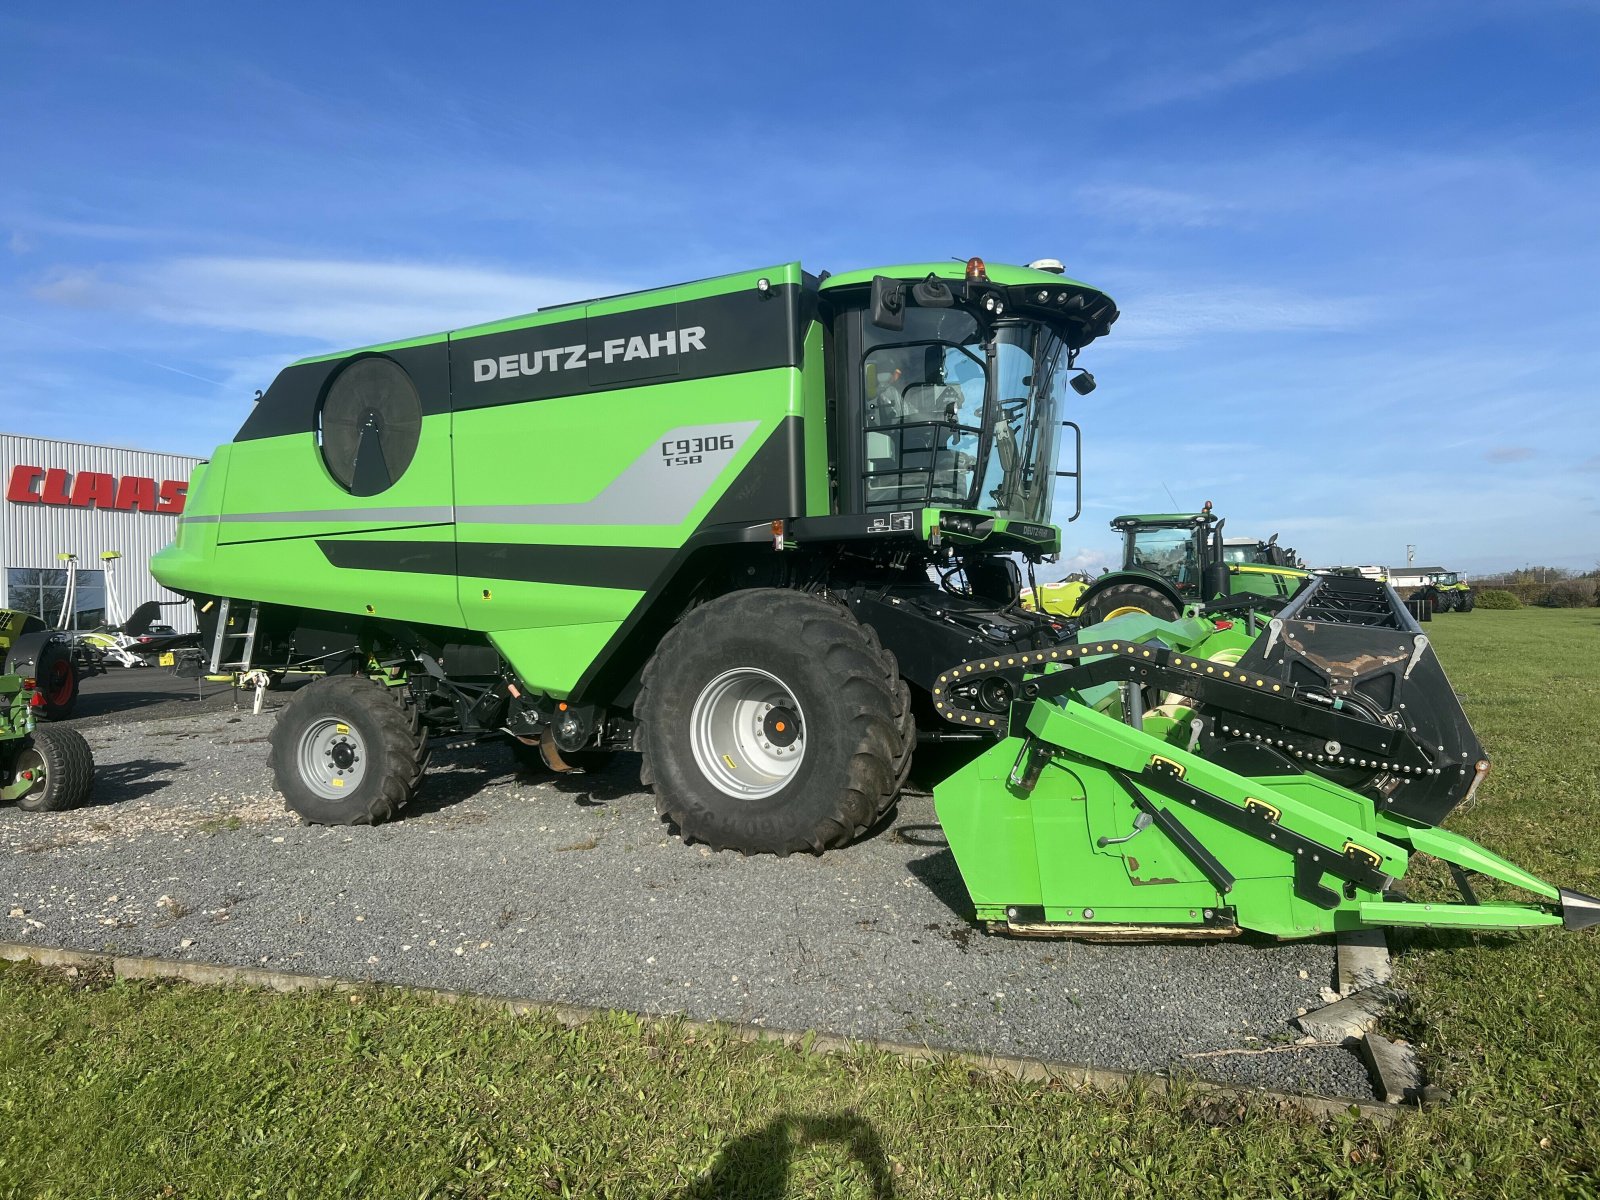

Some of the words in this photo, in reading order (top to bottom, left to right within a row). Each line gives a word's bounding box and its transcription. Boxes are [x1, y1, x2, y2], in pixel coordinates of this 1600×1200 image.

[473, 326, 707, 382] DEUTZ-FAHR
[662, 434, 734, 457] C9306
[663, 455, 702, 466] TSB
[6, 464, 189, 514] CLAAS
